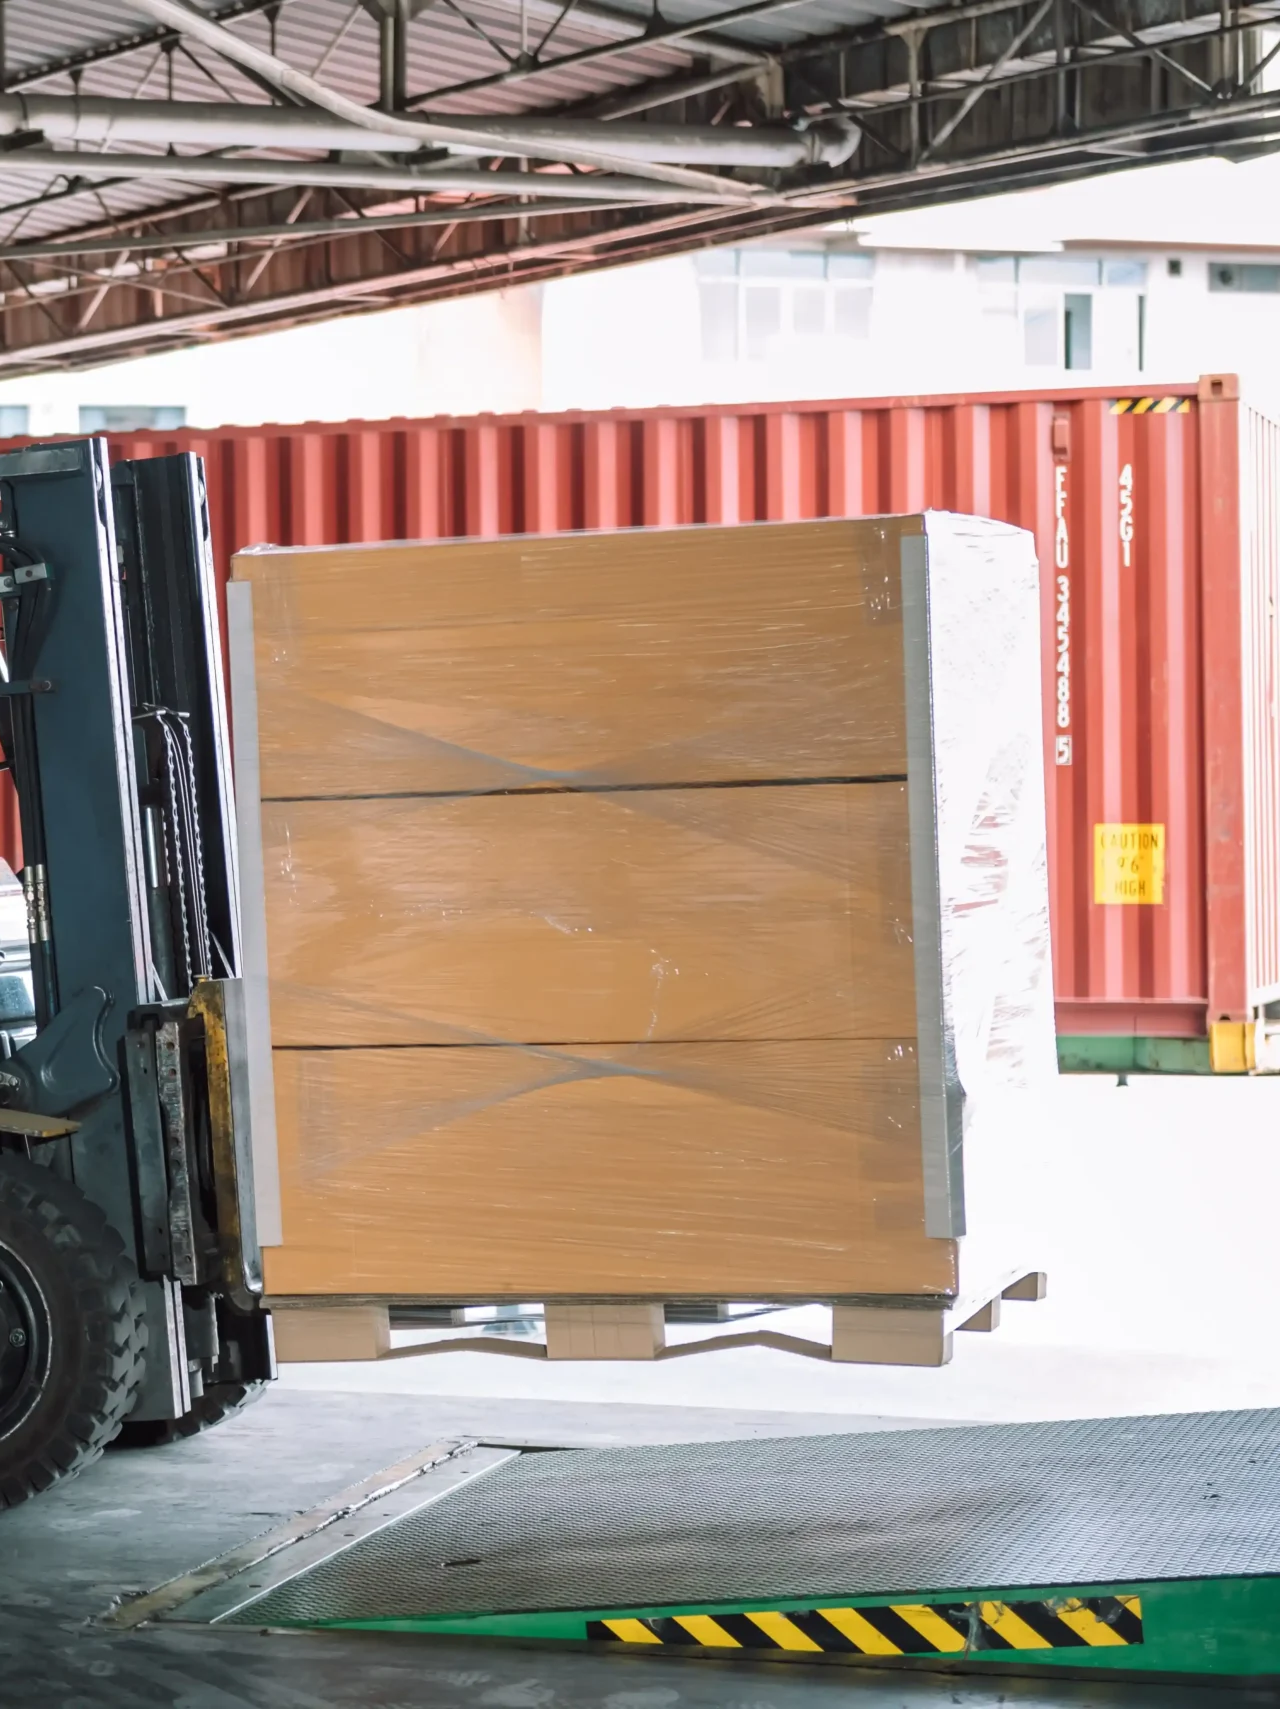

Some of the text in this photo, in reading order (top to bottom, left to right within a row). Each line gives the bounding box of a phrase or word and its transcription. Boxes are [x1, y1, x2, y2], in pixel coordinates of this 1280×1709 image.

[1119, 463, 1134, 568] 45G1
[1055, 465, 1070, 764] FFAU 345488 5
[1100, 832, 1159, 851] CAUTION
[1115, 880, 1146, 897] HIGH
